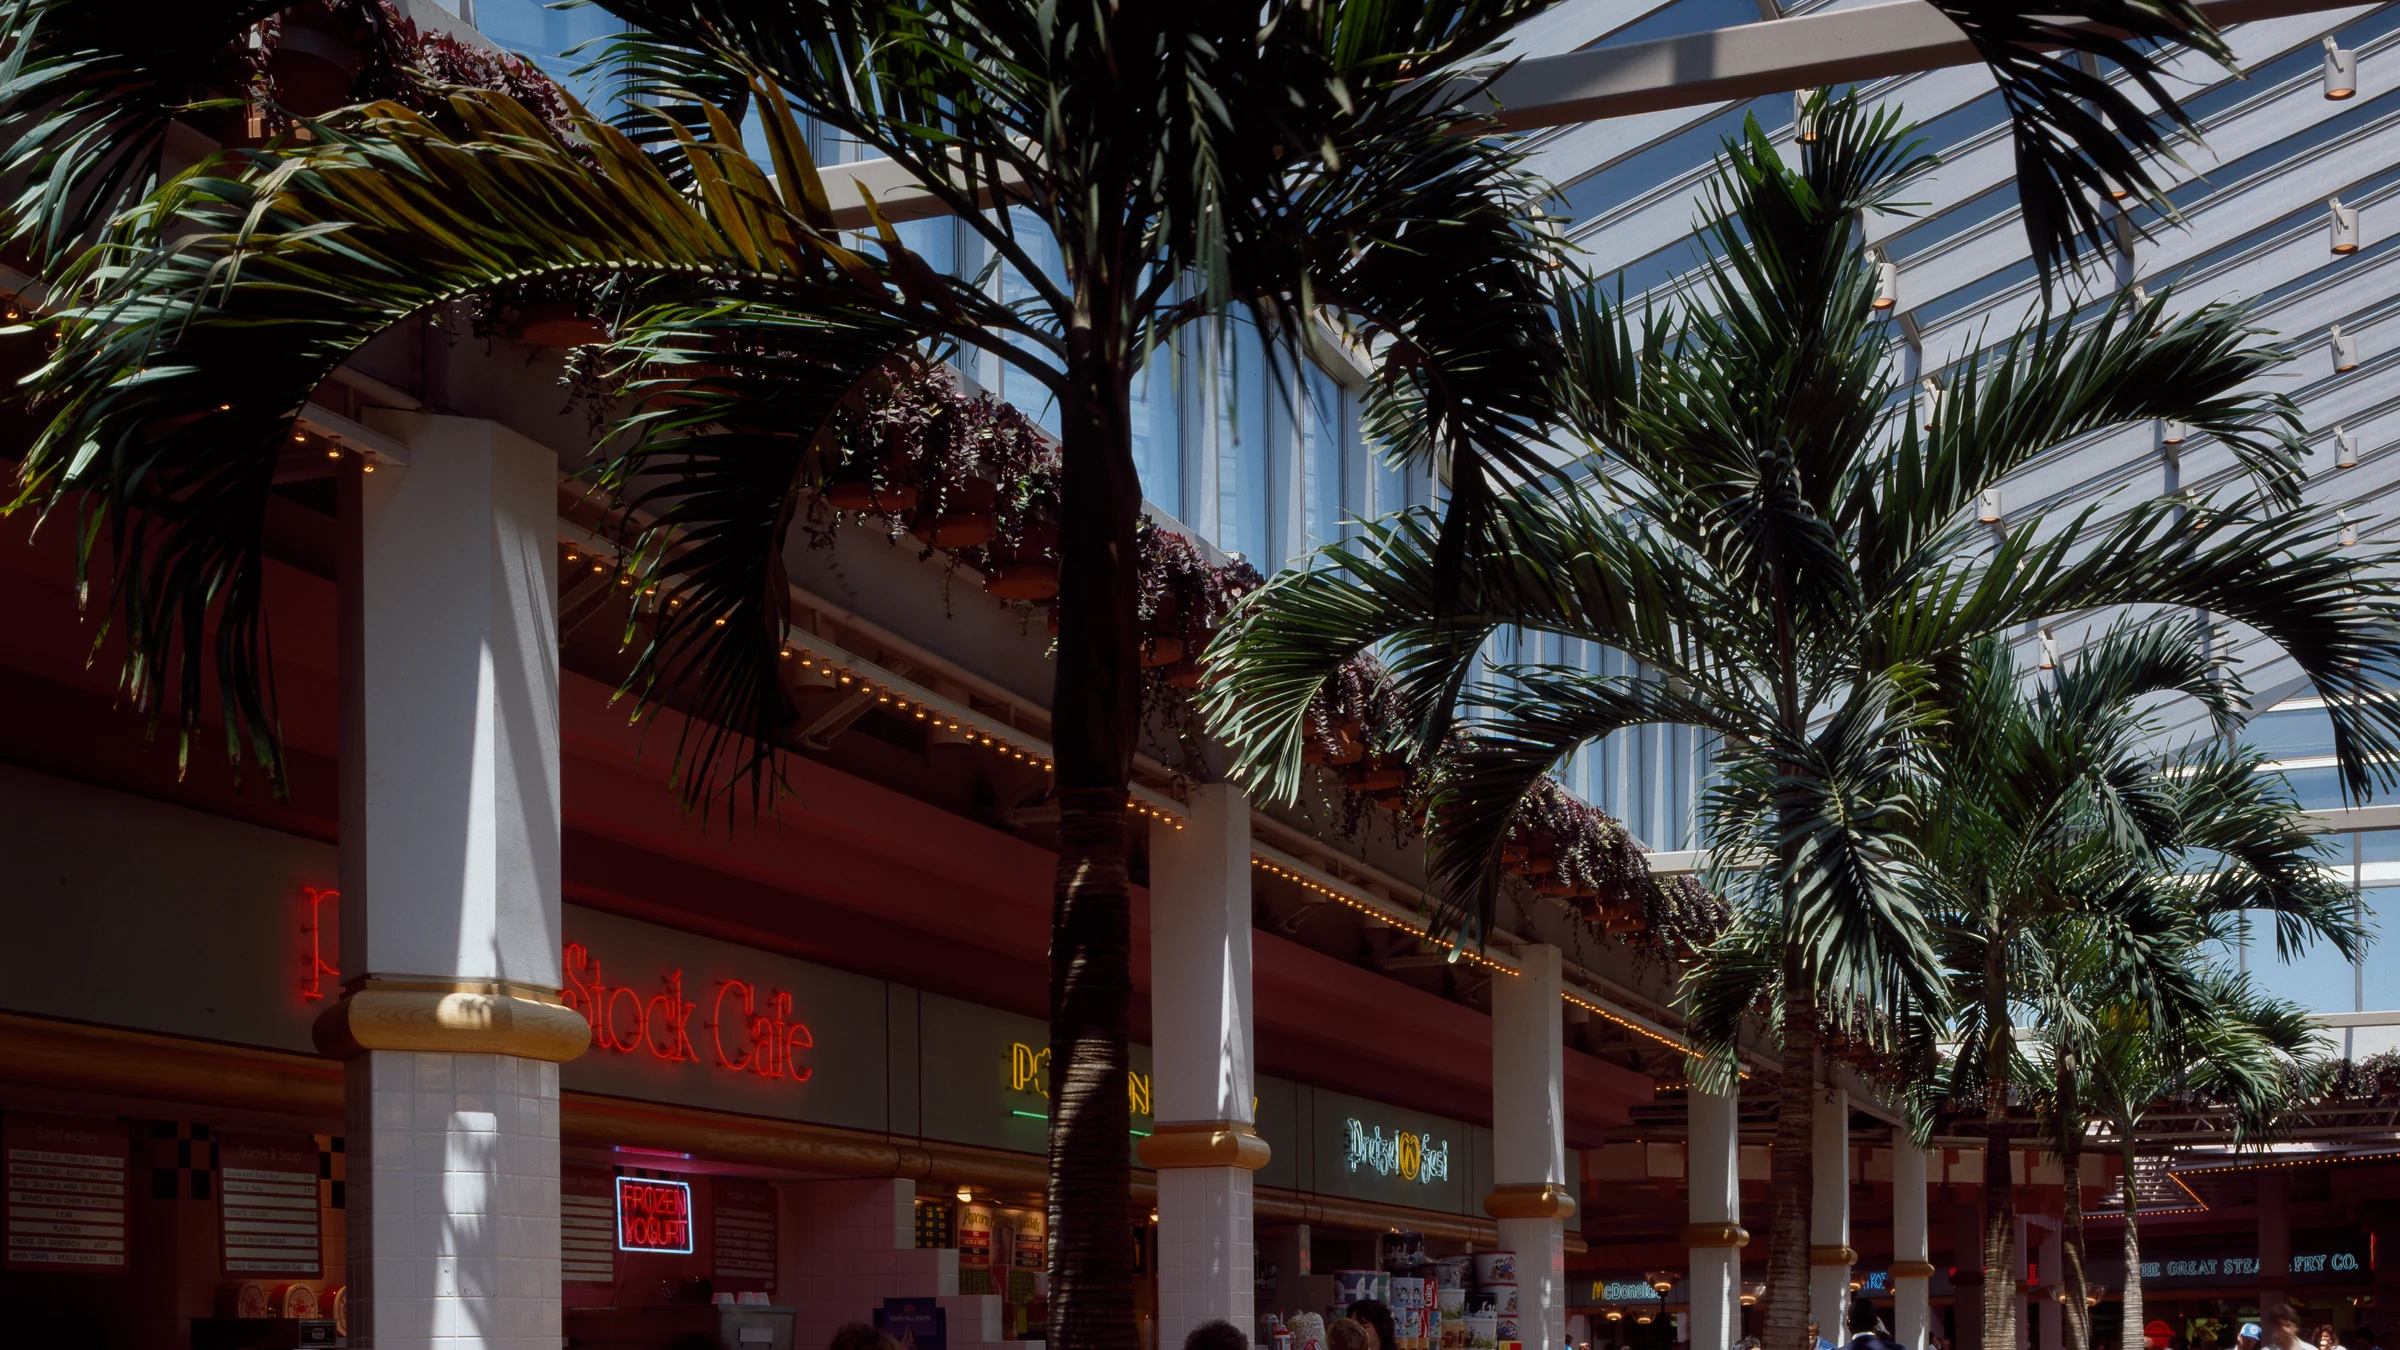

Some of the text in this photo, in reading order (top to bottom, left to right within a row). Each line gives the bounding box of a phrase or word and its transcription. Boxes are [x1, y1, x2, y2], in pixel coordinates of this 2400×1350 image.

[560, 943, 813, 1082] Stock Cafe
[36, 1125, 100, 1144] Sandwiches
[238, 1145, 302, 1164] Quiche & Soup
[20, 1194, 43, 1202] SERVED
[45, 1195, 62, 1203] WITH
[64, 1197, 82, 1205] CHIPS
[622, 1184, 687, 1216] FROZEN
[621, 1216, 688, 1246] YOGURT
[12, 1237, 34, 1245] CHOICE
[49, 1239, 80, 1248] SANDWICH
[12, 1252, 28, 1260] WITH
[31, 1252, 49, 1260] CHIPS
[57, 1254, 77, 1262] PICKLE
[2166, 1260, 2218, 1276] GREAT
[2223, 1258, 2260, 1275] STEA
[2293, 1254, 2327, 1273] FRY
[2331, 1253, 2359, 1271] CO.
[1424, 1284, 1434, 1307] Coke
